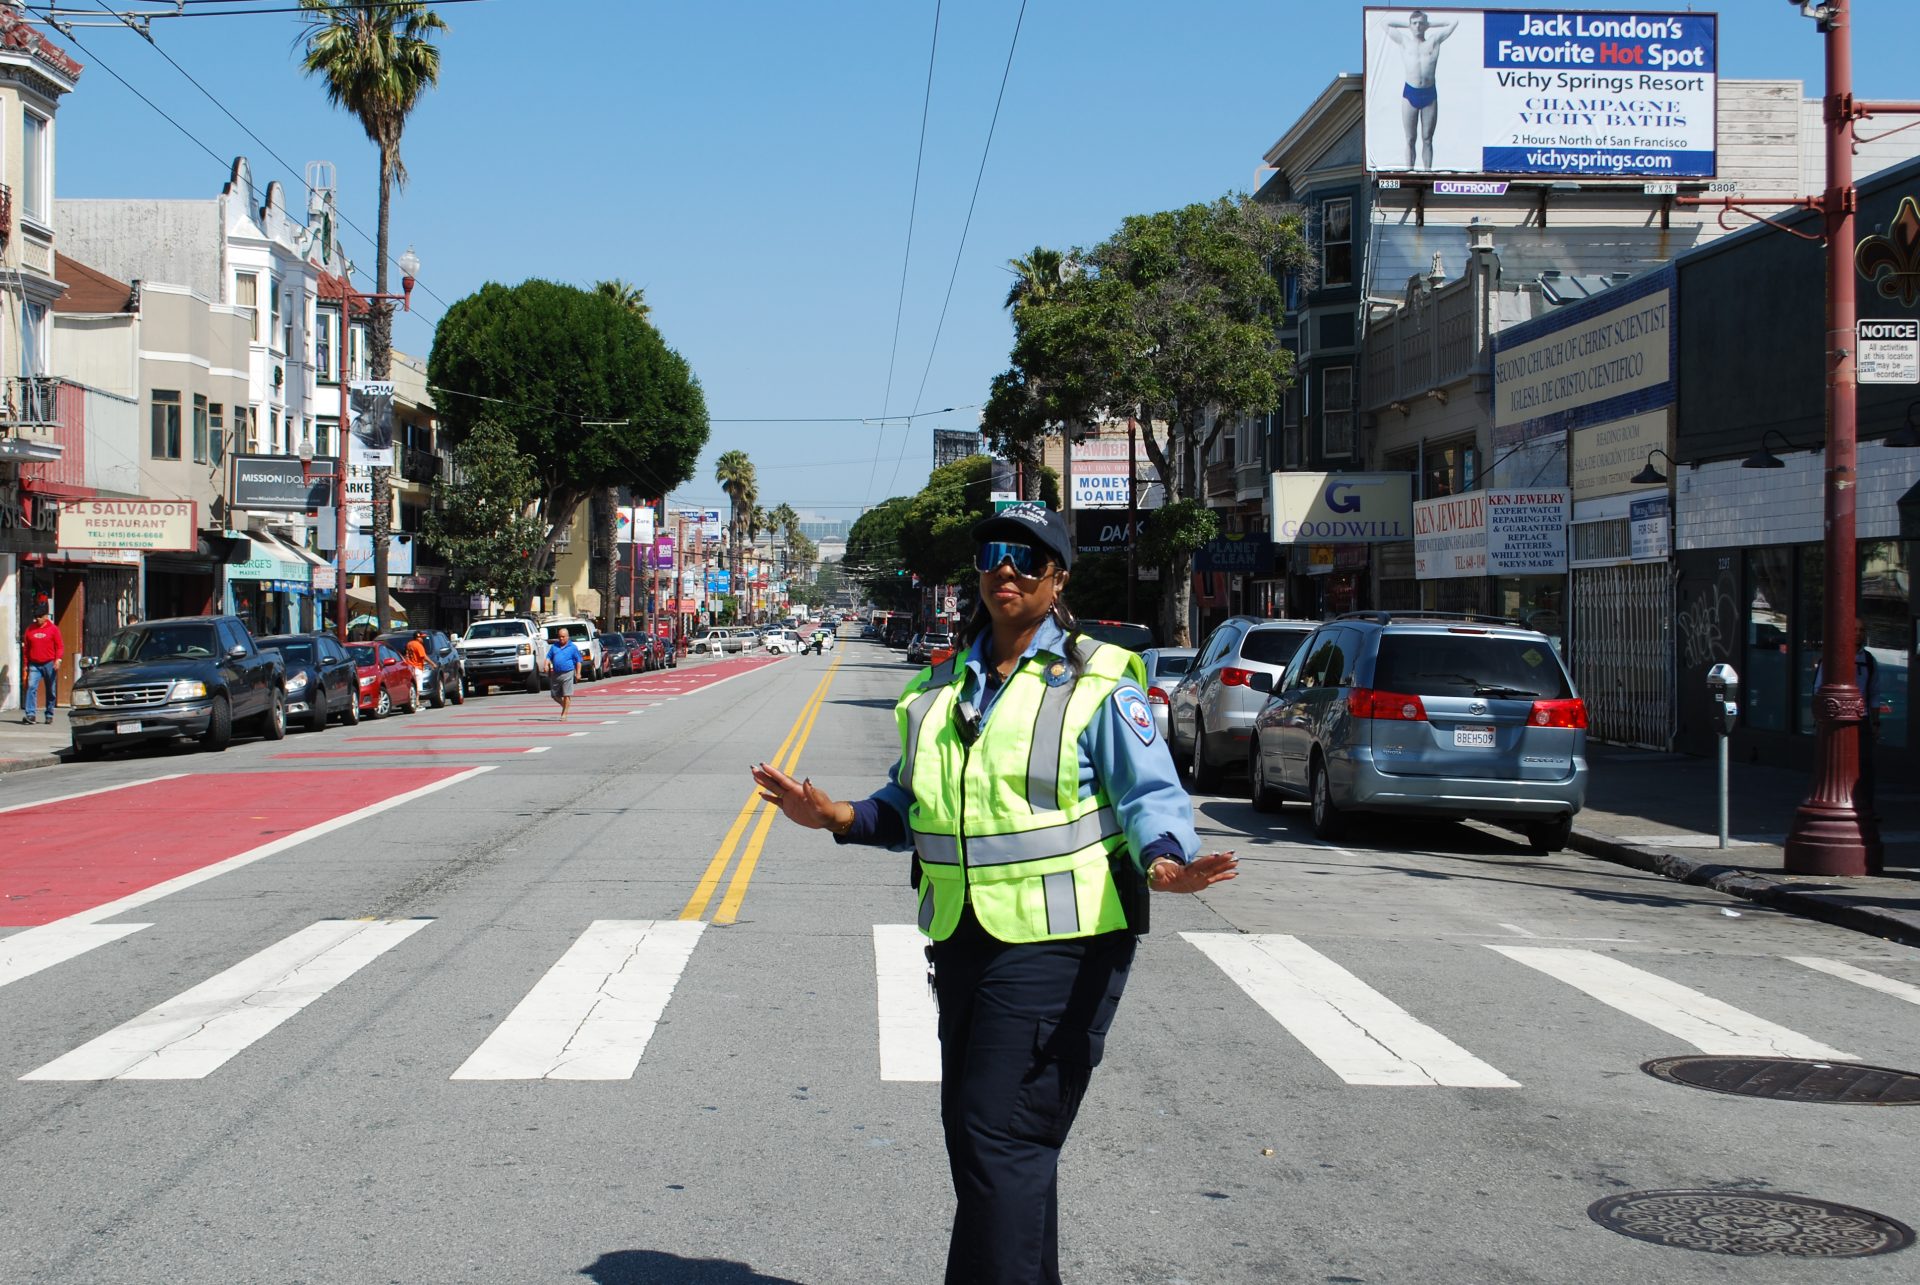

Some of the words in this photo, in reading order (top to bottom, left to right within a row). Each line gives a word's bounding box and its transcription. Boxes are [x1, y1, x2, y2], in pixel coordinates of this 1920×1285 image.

[1519, 14, 1572, 37] Jack
[1576, 16, 1683, 39] London's
[1498, 41, 1595, 63] Favorite
[1600, 43, 1644, 64] Hot
[1648, 43, 1704, 70] Spot
[1497, 71, 1551, 91] Vichy
[1557, 73, 1633, 94] Springs
[1640, 74, 1704, 92] Resort
[1525, 97, 1680, 113] CHAMPAGNE
[1519, 112, 1599, 126] VICHY
[1606, 114, 1687, 128] BATHS
[1512, 134, 1519, 145] 2
[1522, 134, 1556, 145] Hours
[1559, 135, 1592, 146] North
[1595, 135, 1608, 146] of
[1610, 135, 1632, 147] San
[1634, 136, 1688, 148] Francisco
[1526, 149, 1672, 170] vichysprings.com
[1380, 180, 1399, 188] 2338
[1440, 182, 1500, 193] OUTFRONT
[1710, 183, 1736, 192] 3808
[1861, 325, 1916, 338] NOTICE
[1495, 356, 1526, 385] SECOND
[1527, 344, 1563, 375] CHURCH
[1565, 337, 1577, 362] OF
[1578, 324, 1613, 357] CHRIST
[1614, 304, 1667, 345] SCIENTIST
[1869, 343, 1877, 351] All
[1880, 343, 1908, 351] activities
[1873, 352, 1885, 360] this
[1887, 352, 1914, 360] location
[1876, 362, 1890, 371] may
[1511, 385, 1540, 412] IGLESIA
[1541, 380, 1553, 402] DE
[1554, 370, 1587, 400] CRISTO
[1588, 352, 1644, 390] CIENTIFICO
[241, 473, 282, 483] MISSION
[1079, 477, 1130, 488] MONEY
[1325, 483, 1360, 513] G
[1488, 494, 1511, 506] KEN
[1513, 493, 1565, 505] JEWELRY
[65, 503, 86, 514] EL
[92, 503, 188, 516] SALVADOR
[1494, 507, 1528, 515] EXPERT
[1530, 506, 1561, 514] WATCH
[1415, 505, 1435, 535] KEN
[1437, 497, 1485, 533] JEWELRY
[1492, 516, 1540, 524] REPAIRING
[1541, 515, 1563, 523] FAST
[85, 518, 167, 528] RESTAURANT
[1493, 525, 1500, 533] &
[1502, 524, 1562, 533] GUARANTEED
[1282, 520, 1405, 538] GOODWILL
[1508, 533, 1548, 541] REPLACE
[1504, 542, 1552, 550] BATTERIES
[1491, 551, 1521, 559] WHILE
[1523, 551, 1541, 559] YOU
[1543, 550, 1565, 558] WAIT
[1528, 559, 1554, 567] MADE
[1456, 732, 1494, 744] 8BEH509
